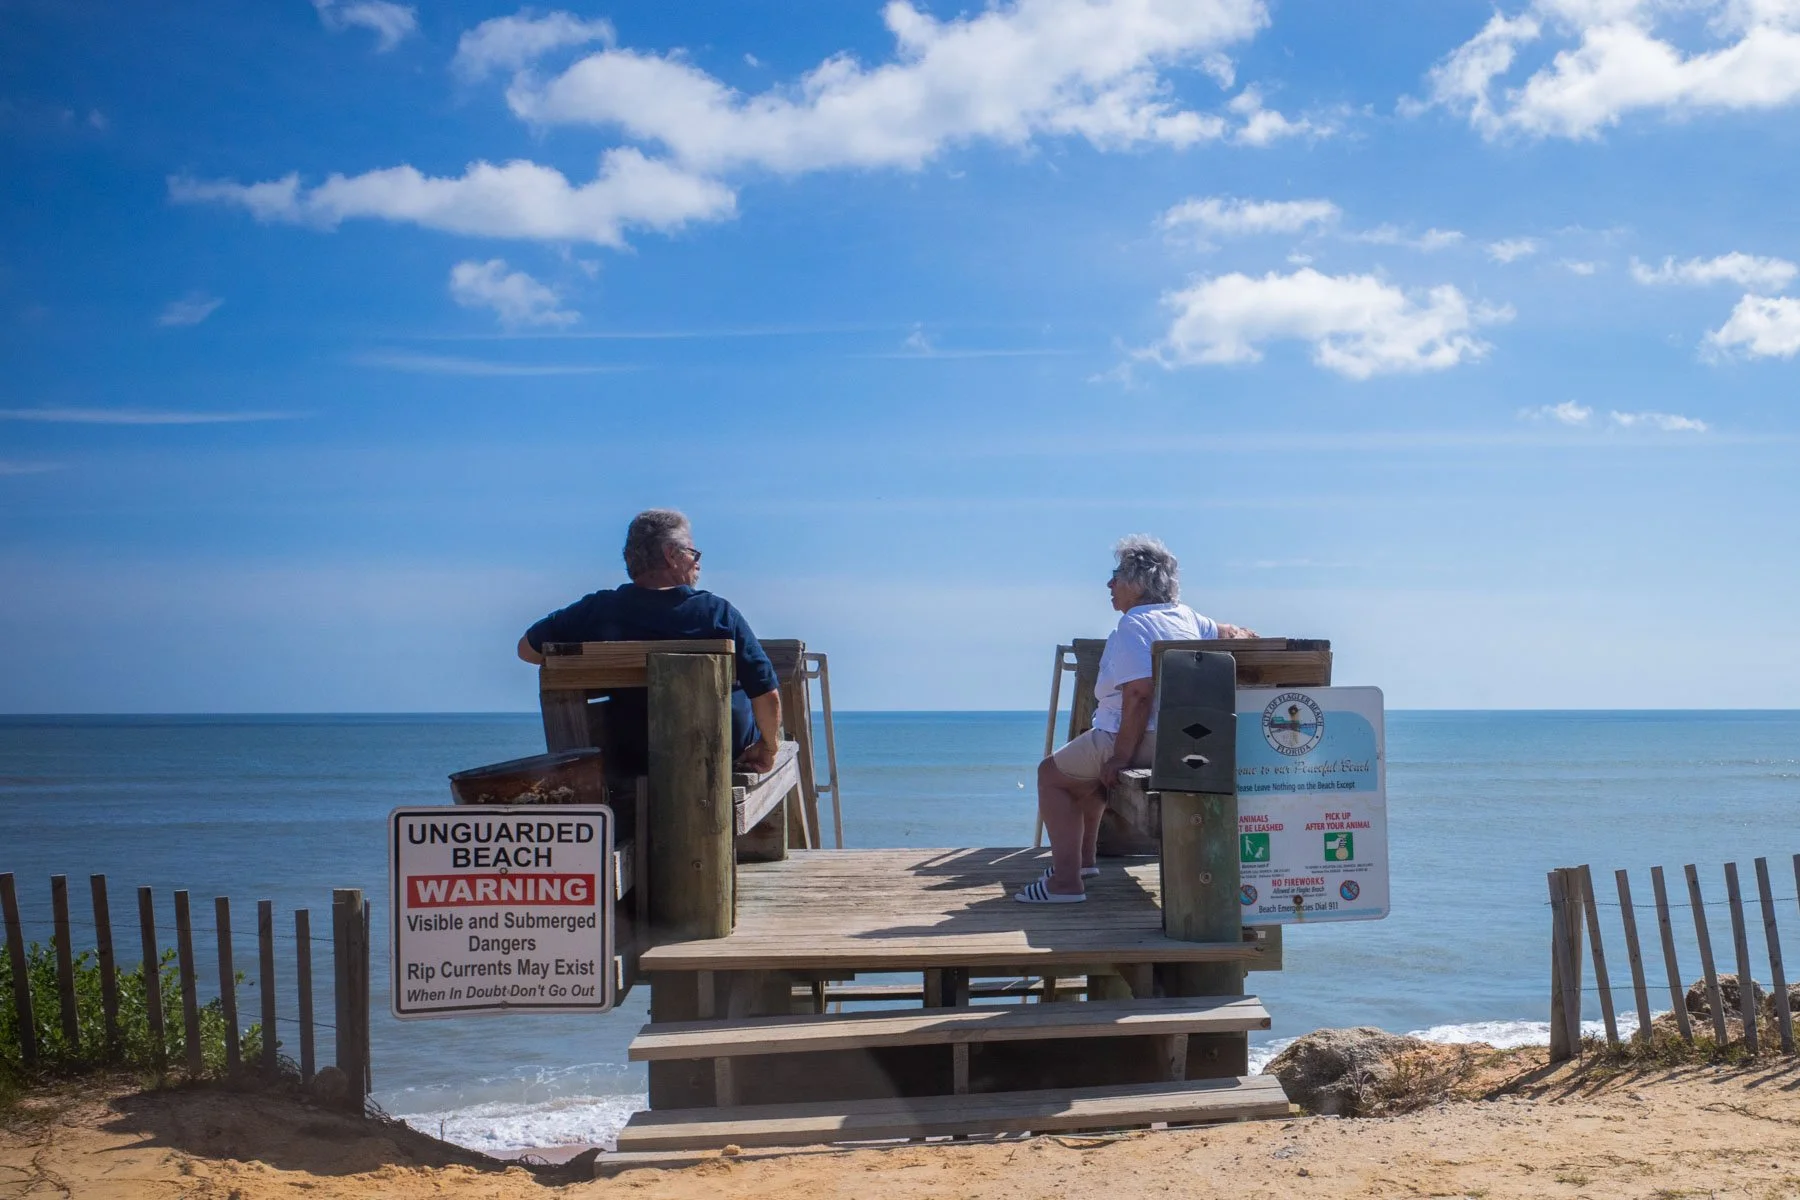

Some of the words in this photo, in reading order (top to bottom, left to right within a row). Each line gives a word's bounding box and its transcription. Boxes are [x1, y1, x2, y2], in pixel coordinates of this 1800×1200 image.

[1278, 694, 1311, 704] FLAGLER
[1310, 702, 1324, 727] BEACH
[1277, 745, 1311, 756] FLORIDA
[1254, 784, 1271, 792] Leave
[1272, 783, 1296, 793] Nothing
[1306, 782, 1316, 790] the
[1317, 781, 1336, 790] Beach
[1336, 780, 1355, 791] Except
[1239, 815, 1269, 823] ANIMALS
[1325, 812, 1340, 821] PICK
[1341, 812, 1351, 820] UP
[408, 822, 594, 845] UNGUARDED
[1254, 823, 1284, 832] LEASHED
[1305, 822, 1325, 831] AFTER
[1326, 822, 1345, 830] YOUR
[1346, 821, 1371, 829] ANIMAL
[452, 847, 552, 868] BEACH
[1272, 879, 1282, 887] NO
[1284, 877, 1325, 887] FIREWORKS
[416, 878, 587, 903] WARNING
[1258, 905, 1277, 913] Beach
[1315, 902, 1327, 911] Dial
[1328, 901, 1339, 910] 911
[407, 915, 463, 931] Visible
[469, 913, 499, 929] and
[504, 912, 596, 932] Submerged
[469, 936, 536, 954] Dangers
[408, 963, 435, 982] Rip
[441, 961, 512, 979] Currents
[517, 959, 550, 979] May
[555, 959, 595, 976] Exist
[407, 989, 445, 1002] When
[450, 987, 461, 999] In
[466, 985, 507, 998] Doubt
[510, 985, 545, 997] Don't
[549, 985, 567, 996] Go
[571, 984, 595, 997] Out
